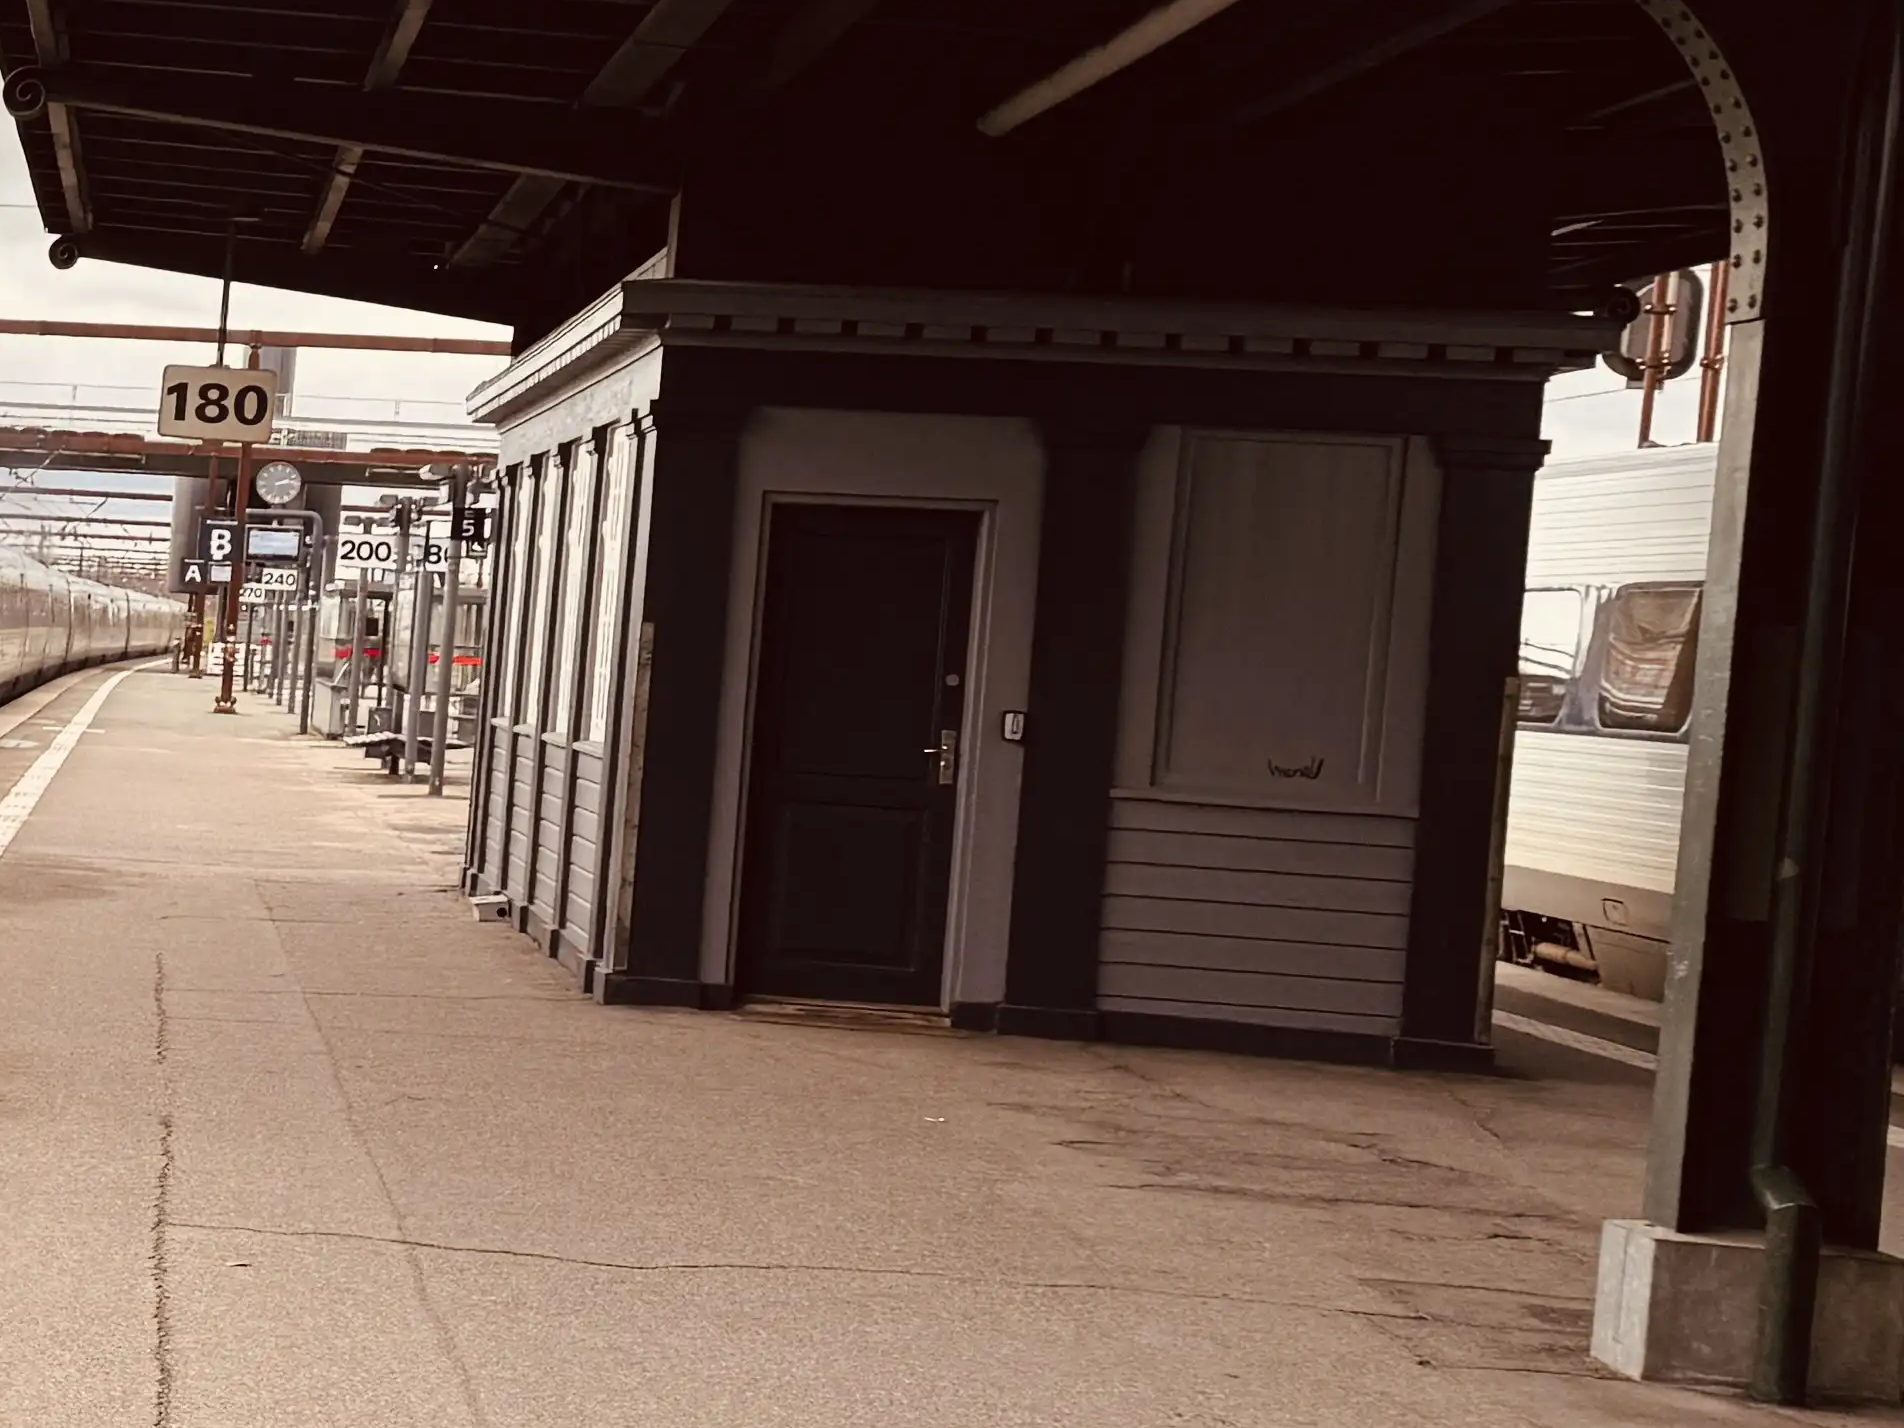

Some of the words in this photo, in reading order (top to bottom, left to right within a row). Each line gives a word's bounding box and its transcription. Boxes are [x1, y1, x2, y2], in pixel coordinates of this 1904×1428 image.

[166, 382, 269, 426] 180
[462, 519, 475, 537] 5
[340, 539, 392, 562] 200
[184, 564, 202, 583] A
[263, 572, 297, 586] 240
